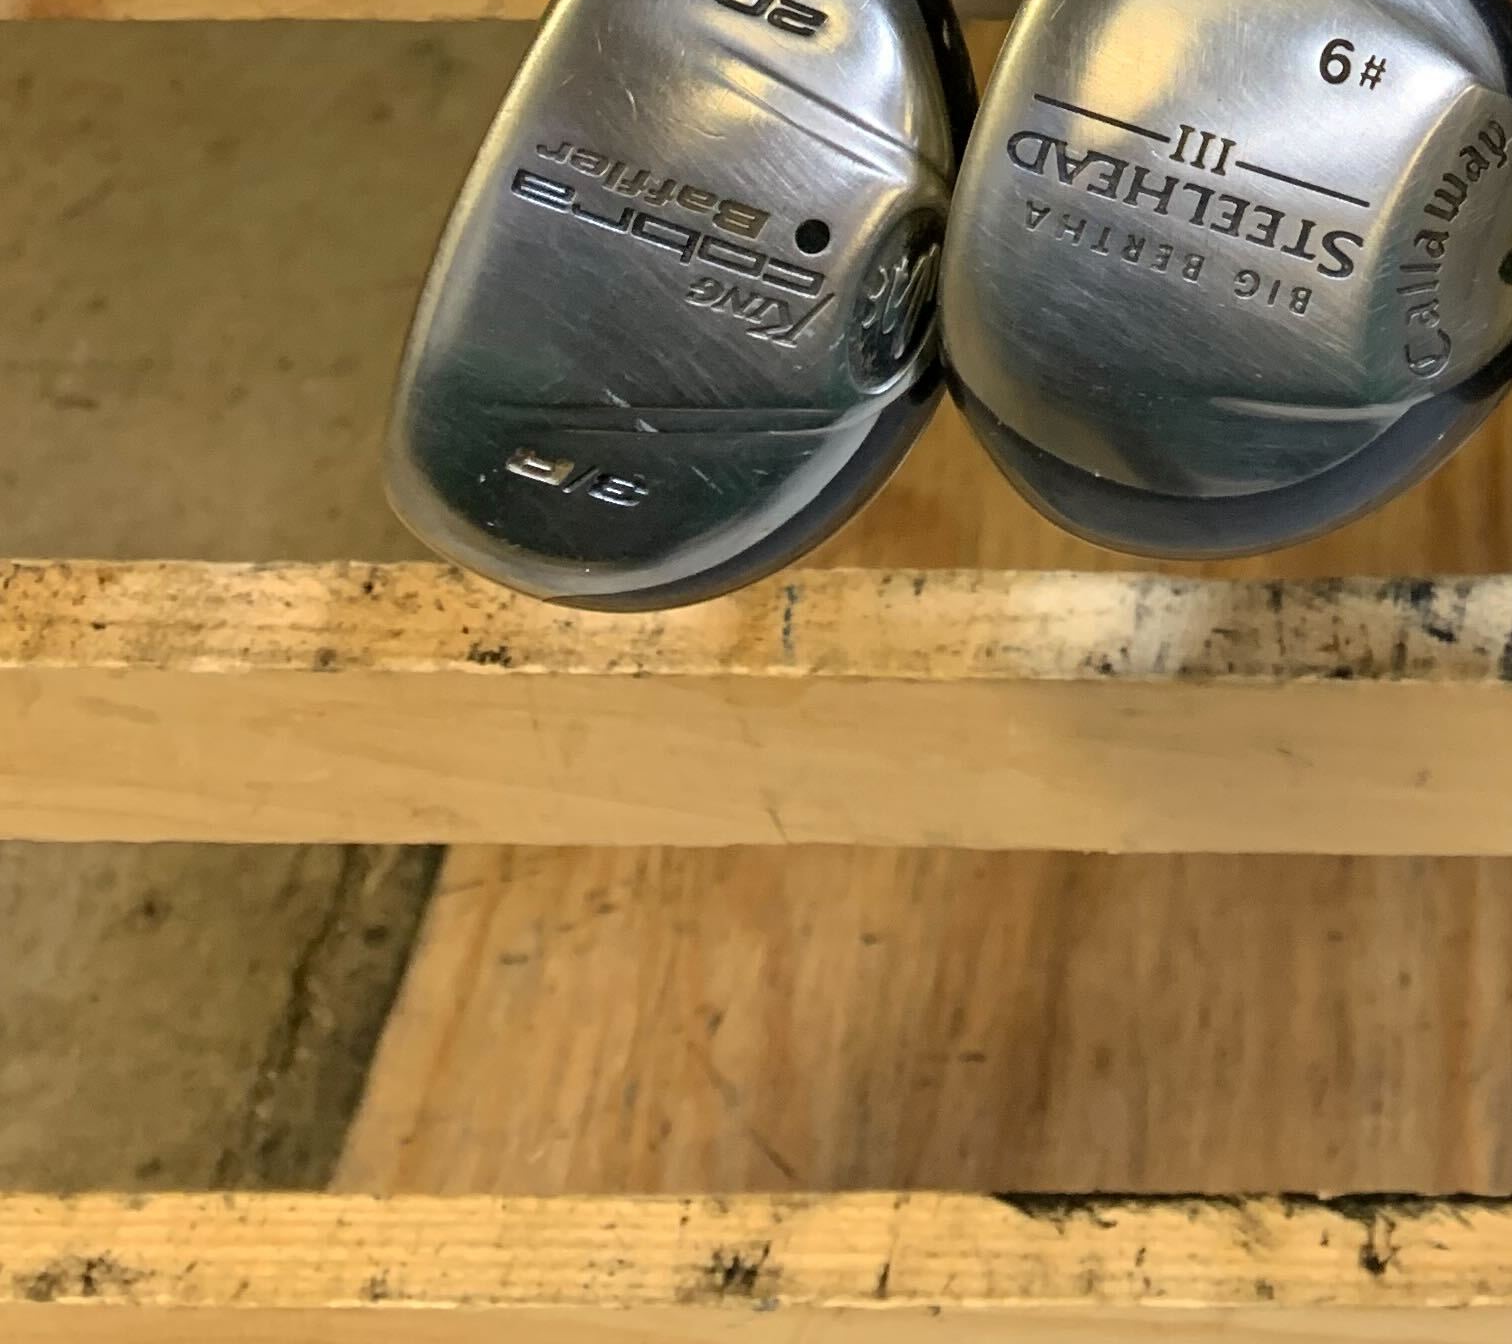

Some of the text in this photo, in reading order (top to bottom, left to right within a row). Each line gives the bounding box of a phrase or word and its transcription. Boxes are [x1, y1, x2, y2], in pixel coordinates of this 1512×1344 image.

[1318, 38, 1387, 90] #9
[536, 141, 771, 240] Baffler
[1170, 124, 1237, 175] III
[1006, 130, 1365, 279] STEELHEAD
[1024, 199, 1314, 316] BIG BERTHA
[1397, 117, 1512, 379] Callaway
